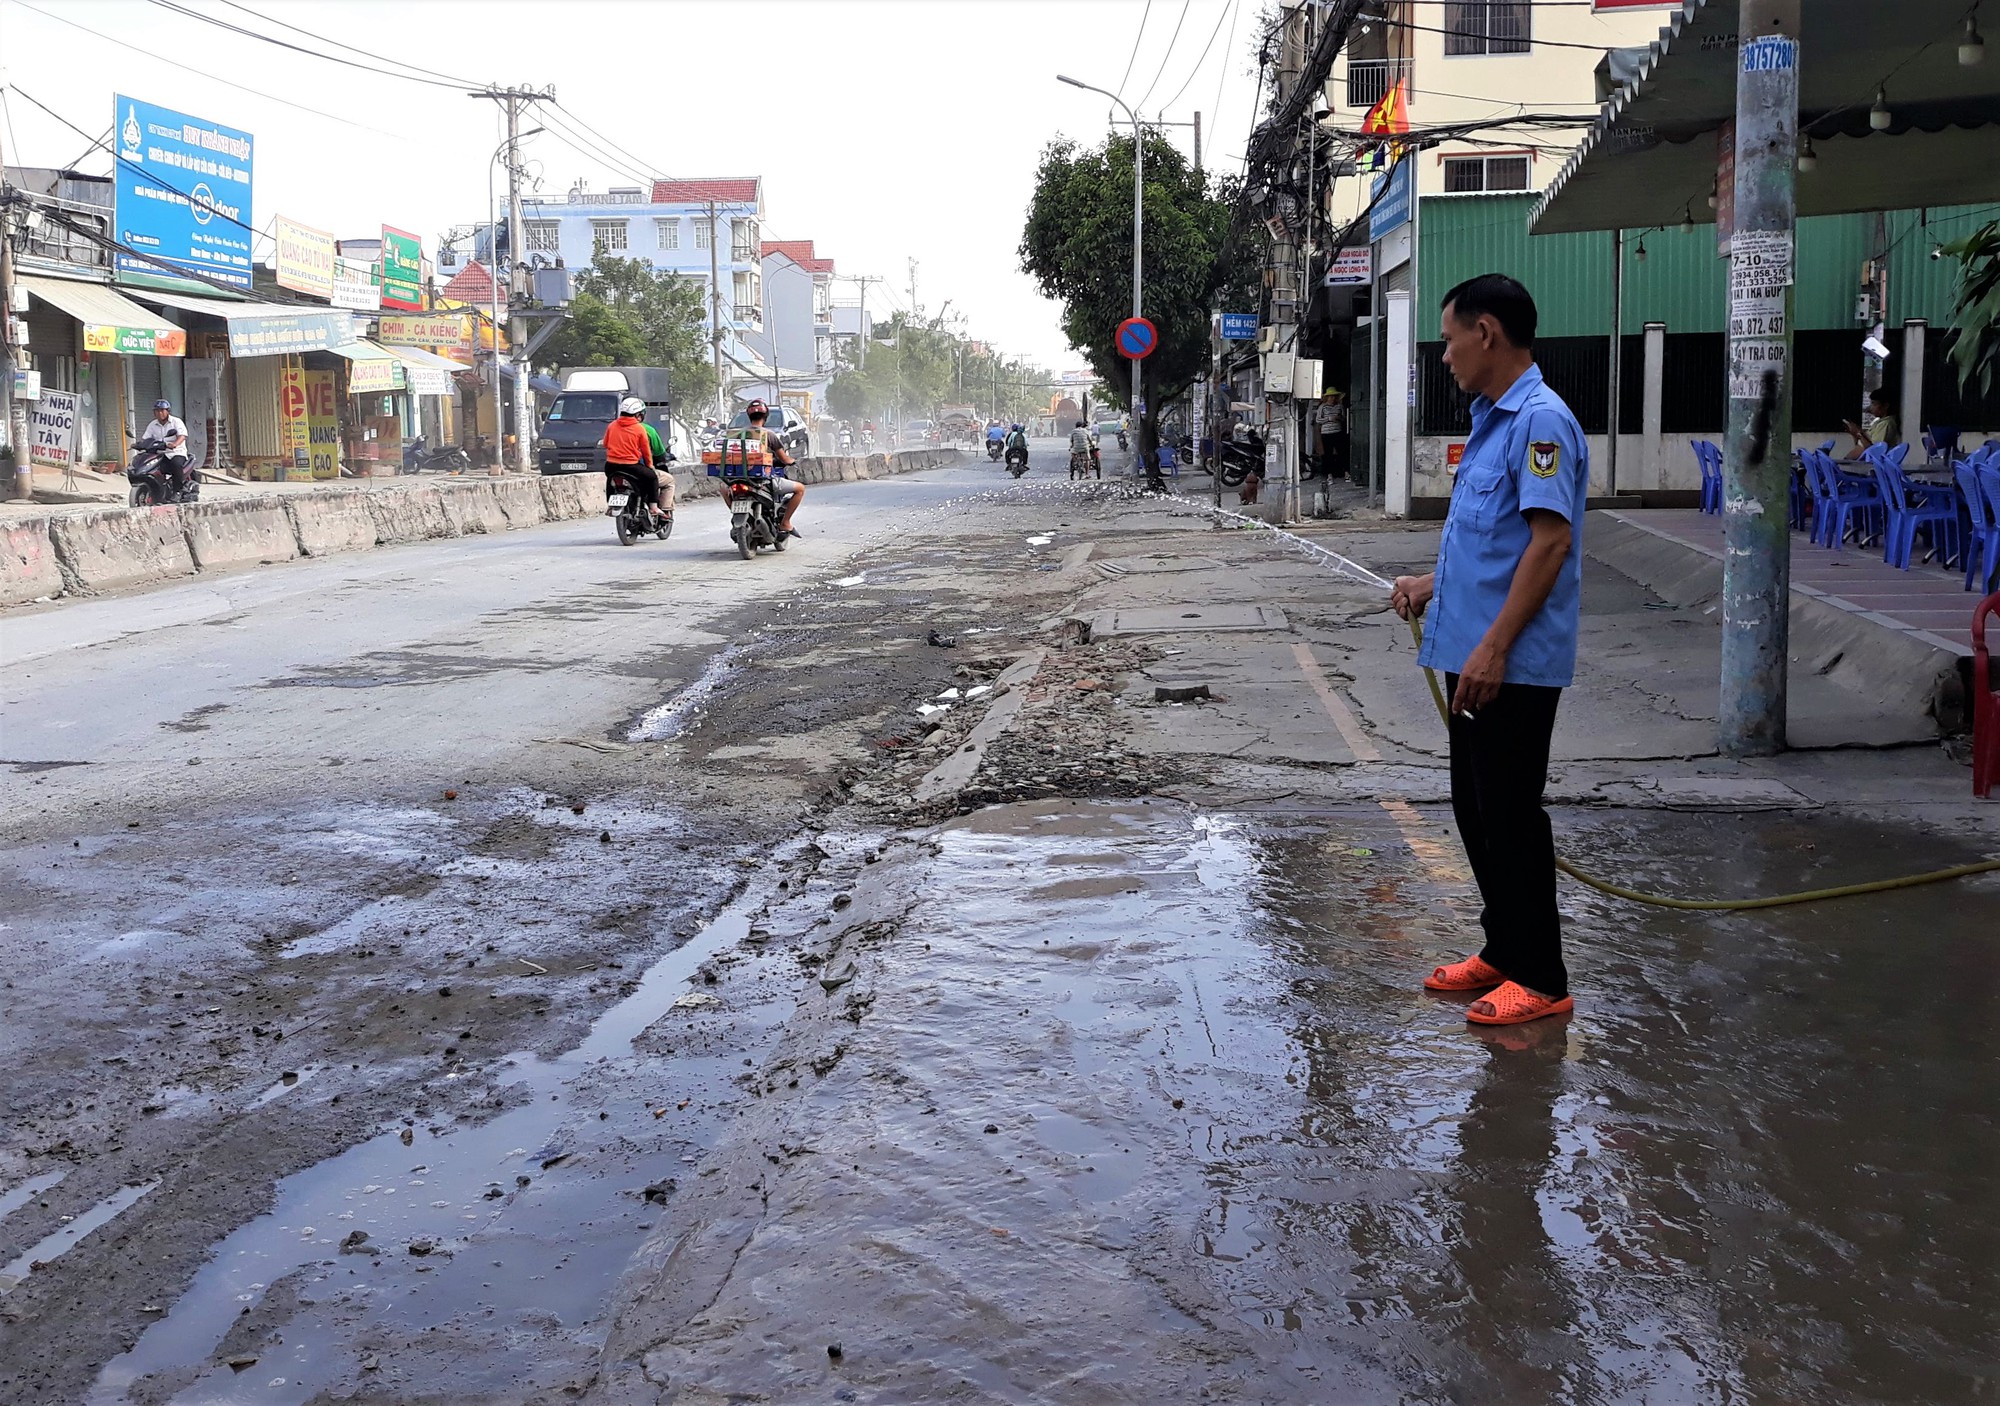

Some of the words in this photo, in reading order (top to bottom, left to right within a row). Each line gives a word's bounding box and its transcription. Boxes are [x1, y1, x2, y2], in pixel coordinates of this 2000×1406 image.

[215, 199, 240, 219] door
[1733, 254, 1762, 268] 7-10
[382, 321, 405, 335] CHIM
[1768, 316, 1784, 334] 437
[122, 335, 138, 348] ĐỨC
[139, 337, 155, 351] VIỆT
[49, 395, 74, 411] NHÀ
[32, 411, 73, 430] THUỐC
[38, 429, 62, 446] TÂY
